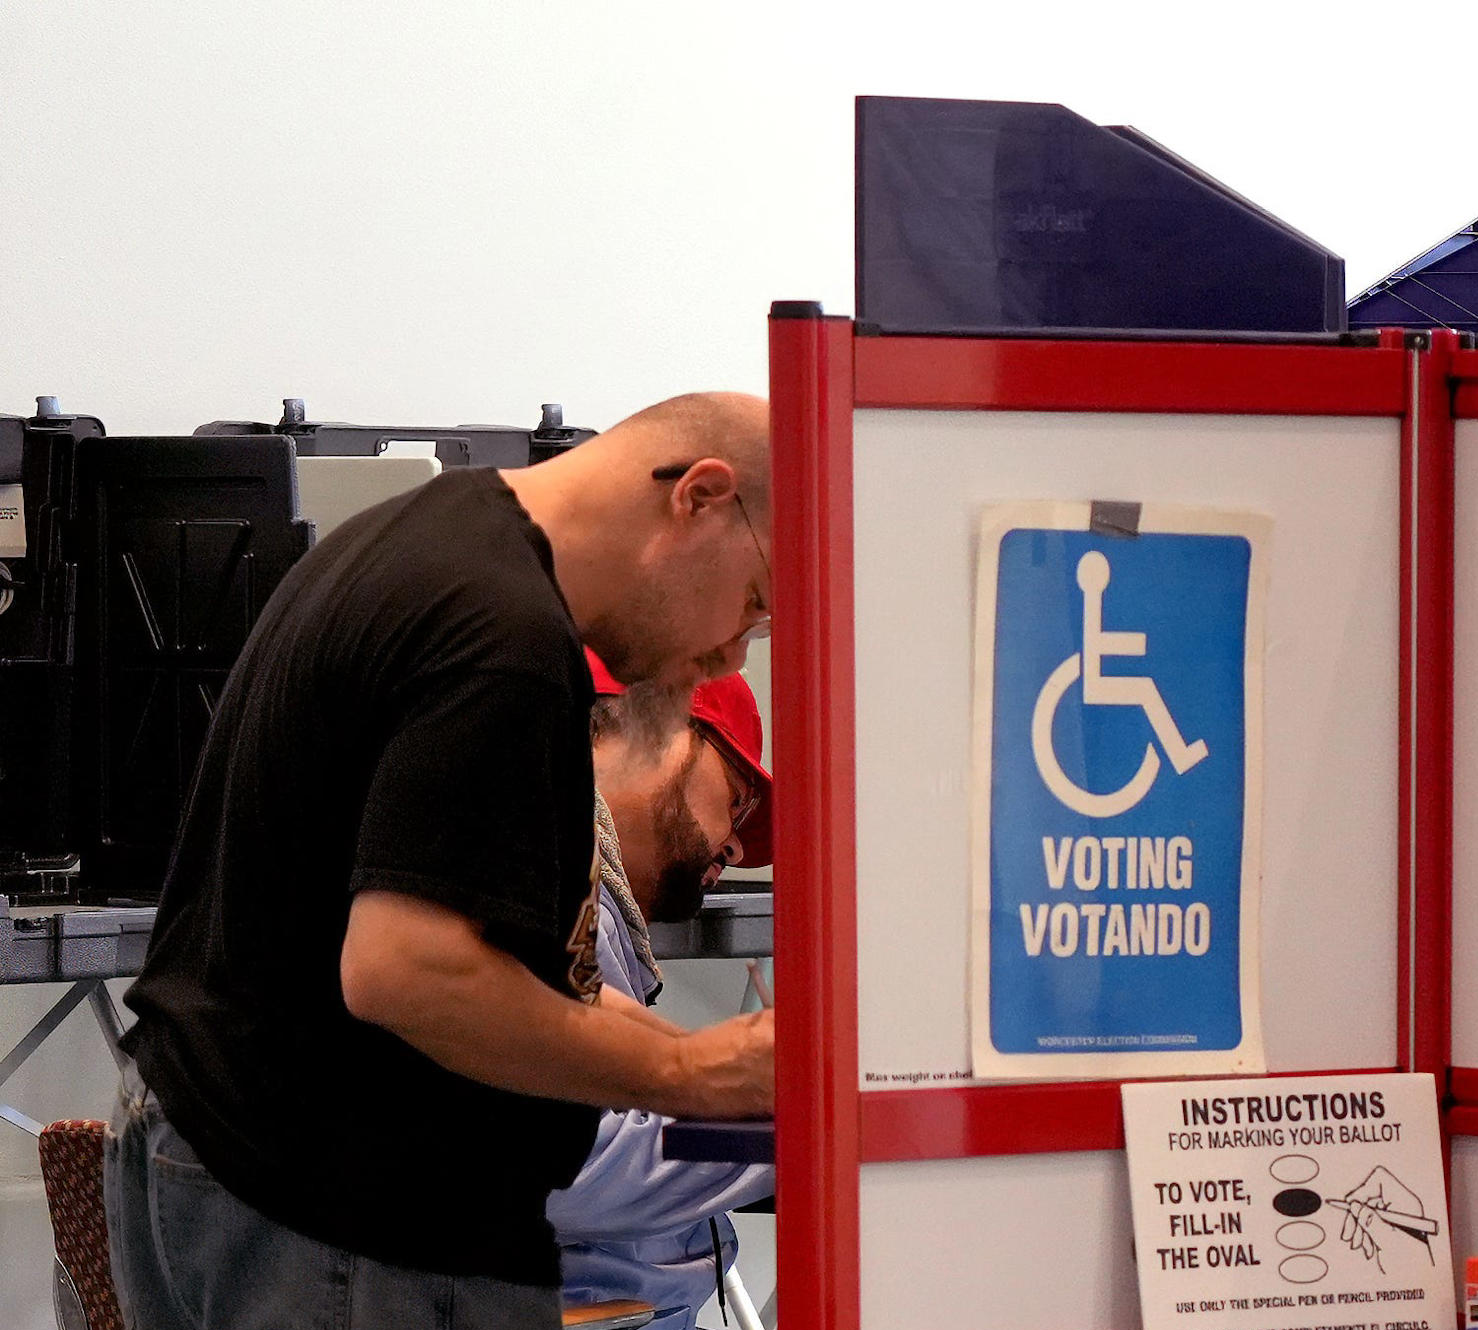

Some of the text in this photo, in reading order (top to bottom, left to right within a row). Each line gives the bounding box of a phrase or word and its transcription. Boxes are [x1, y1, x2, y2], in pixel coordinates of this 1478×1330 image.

[1042, 835, 1194, 892] VOTING
[1019, 902, 1211, 958] VOTANDO
[891, 1071, 930, 1084] weight
[1181, 1091, 1386, 1126] INSTRUCTIONS
[1168, 1123, 1402, 1151] FOR MARKING YOUR BALLOT
[1154, 1179, 1252, 1206] TO VOTE,
[1169, 1212, 1243, 1238] FILL-IN
[1156, 1244, 1261, 1271] THE OVAL
[1176, 1288, 1425, 1314] USE ONLY THE SPECIAL PEN OR PENCIL PROVIDED
